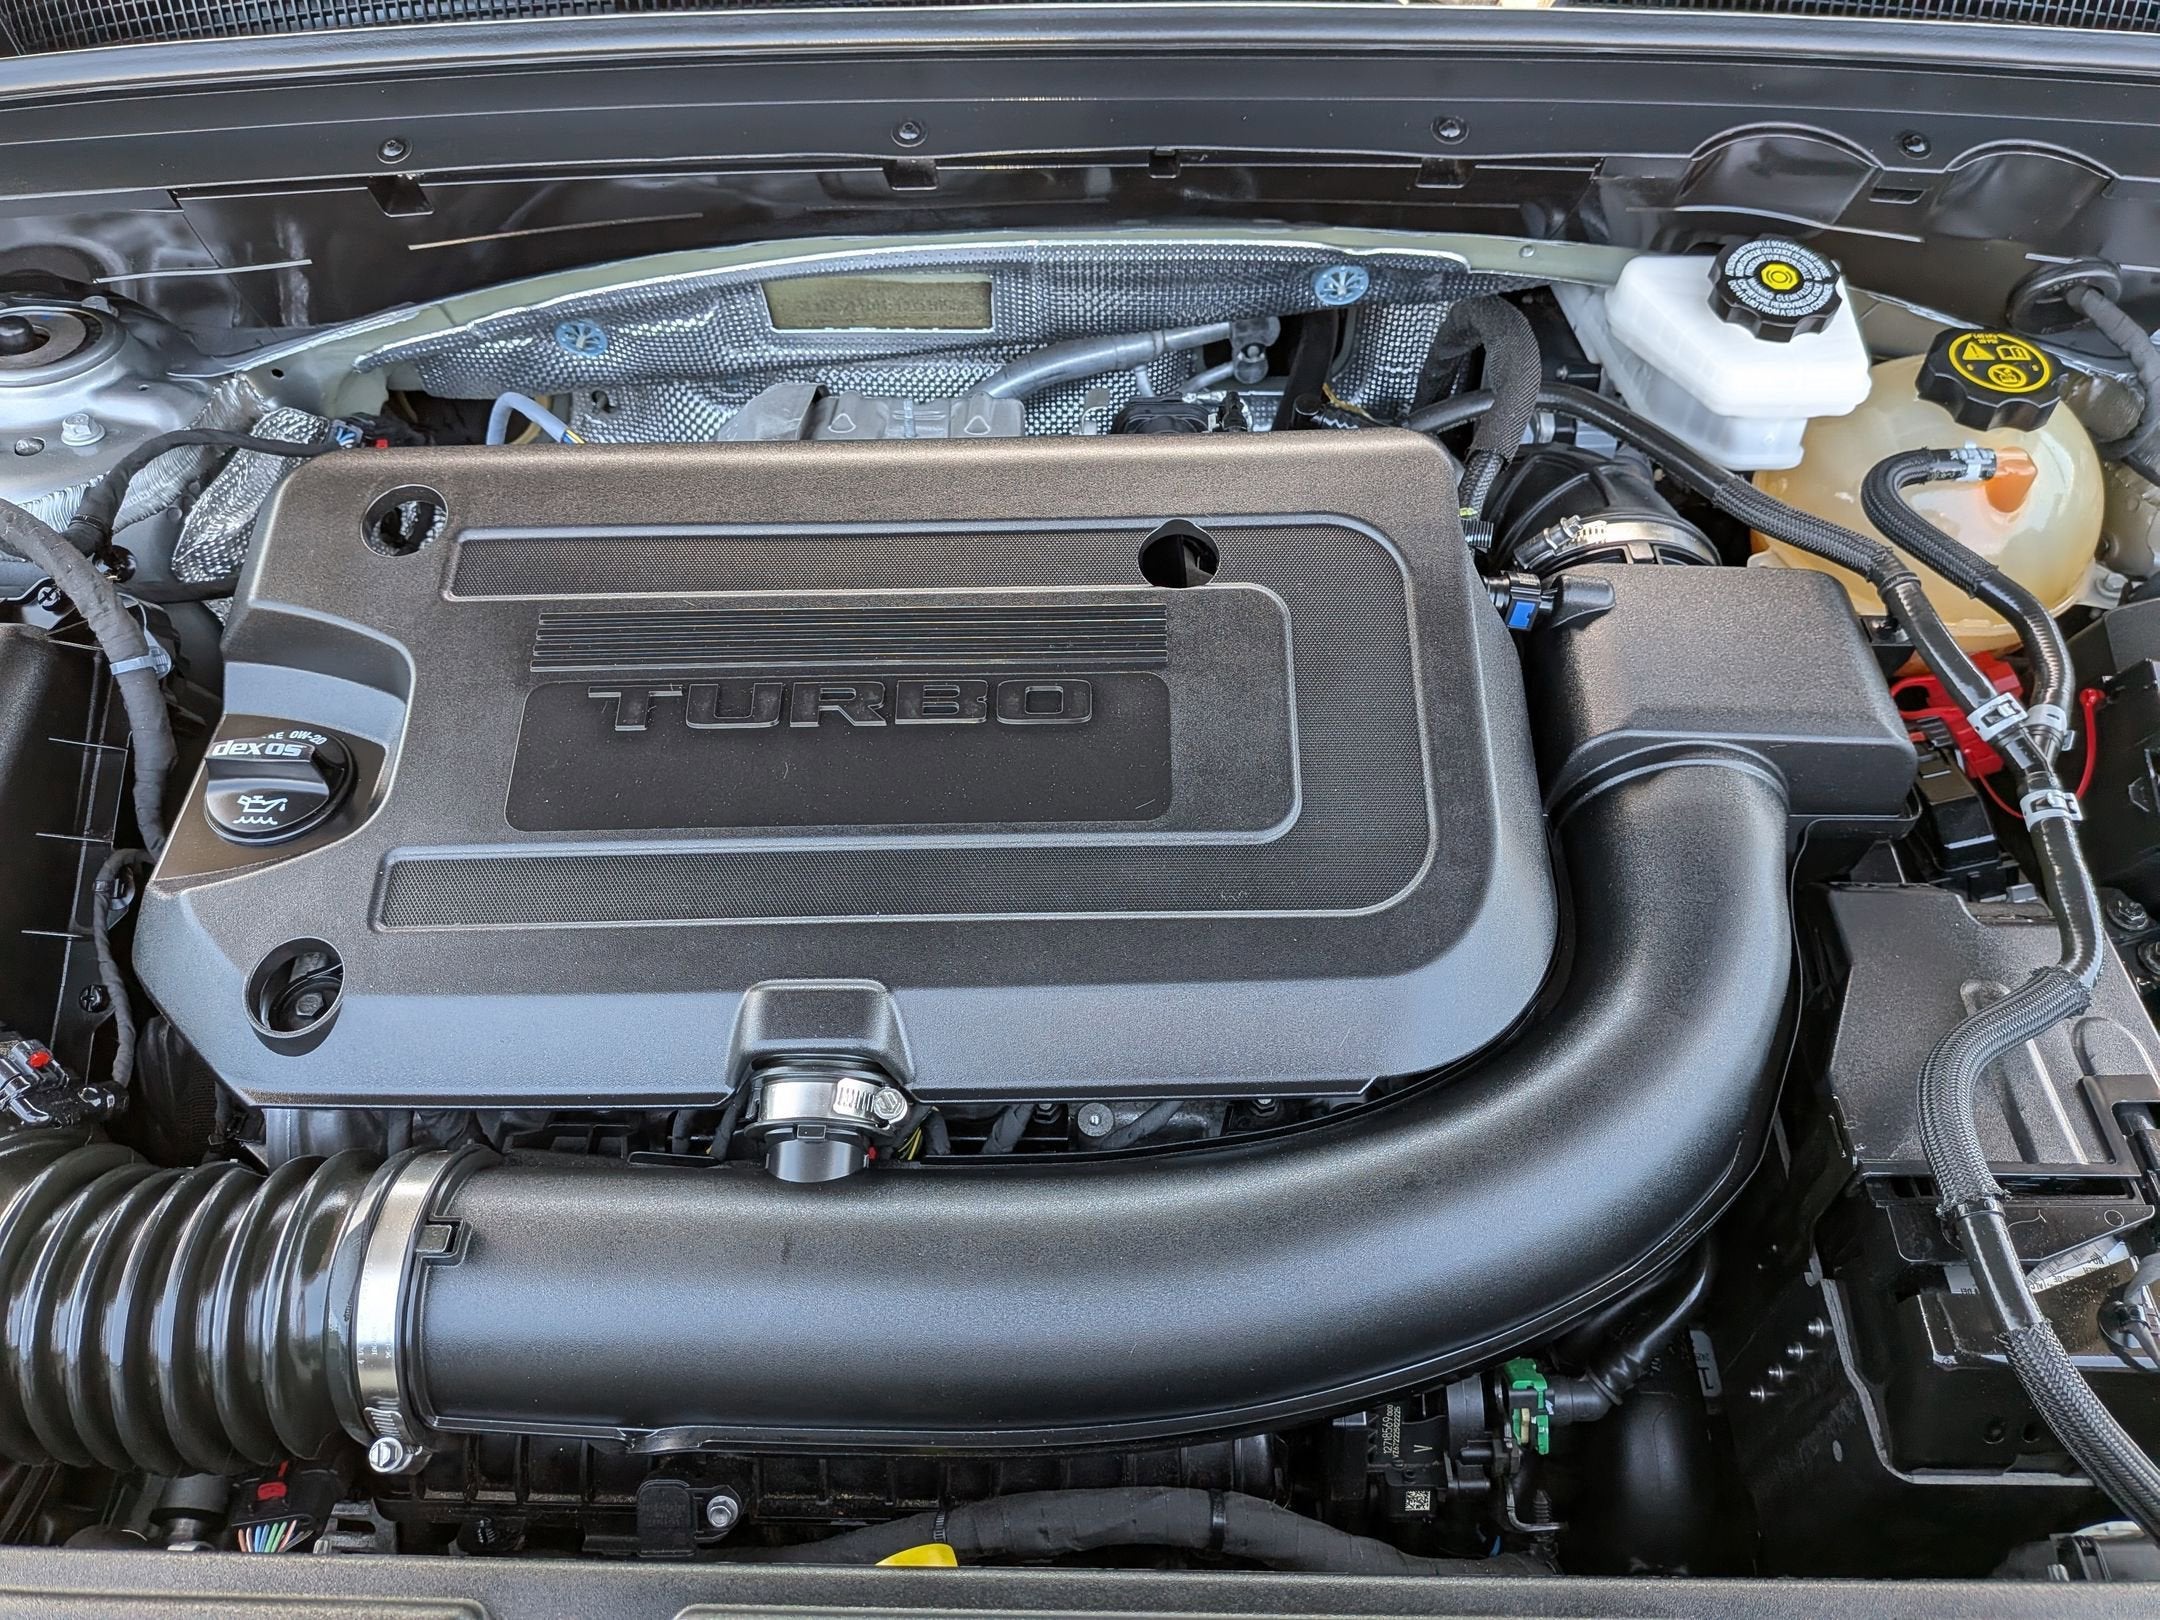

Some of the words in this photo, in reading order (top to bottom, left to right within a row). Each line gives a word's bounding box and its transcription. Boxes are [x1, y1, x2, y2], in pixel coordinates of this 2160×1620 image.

[1756, 303, 1780, 316] FROM
[588, 678, 1093, 731] TURBO
[289, 730, 328, 745] 0W-20
[212, 740, 308, 757] dexos
